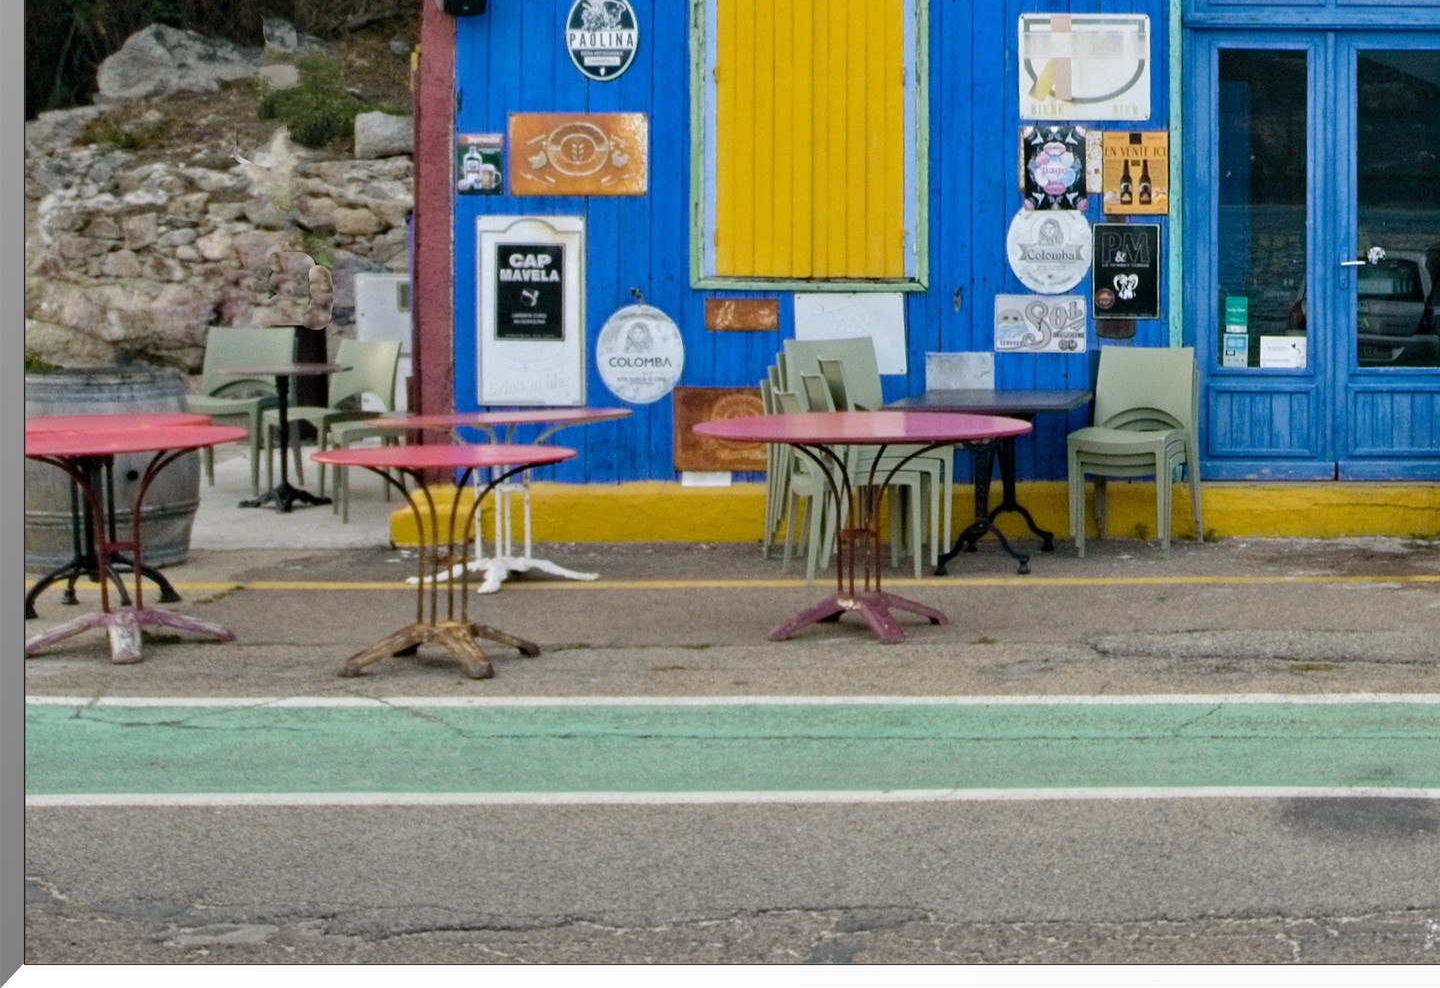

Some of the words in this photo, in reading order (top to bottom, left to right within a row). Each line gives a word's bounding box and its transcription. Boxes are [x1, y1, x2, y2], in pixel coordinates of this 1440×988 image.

[569, 33, 635, 47] PAOLINA
[509, 253, 553, 269] CAP
[1026, 248, 1076, 262] Colomba
[499, 268, 560, 282] MAVELA
[608, 357, 673, 368] COLOMBA
